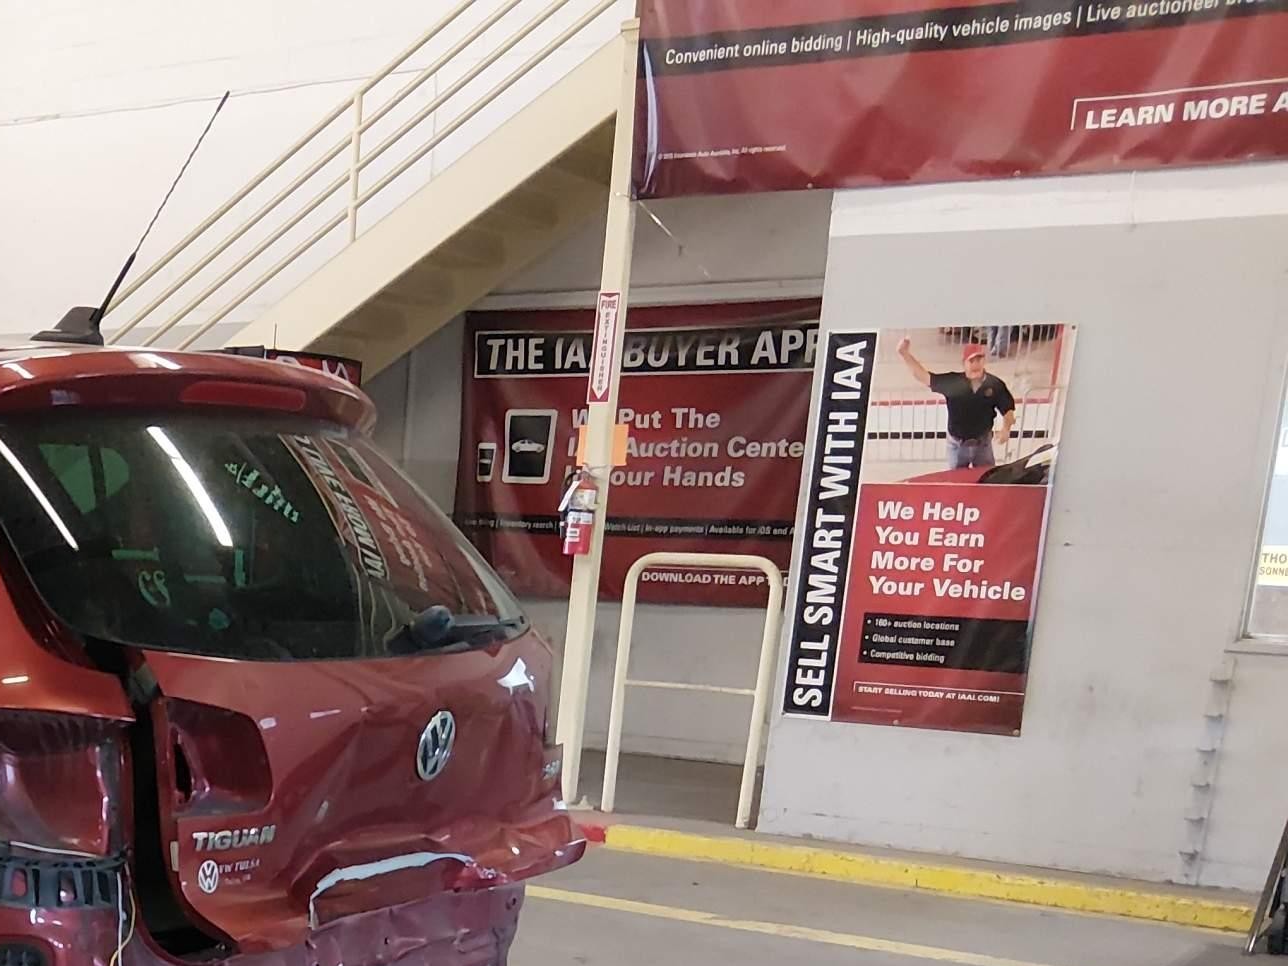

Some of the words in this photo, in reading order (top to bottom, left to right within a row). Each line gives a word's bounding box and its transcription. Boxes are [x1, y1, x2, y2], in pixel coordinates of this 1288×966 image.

[665, 43, 740, 65] Convenient
[743, 39, 787, 57] online
[791, 34, 843, 56] bidding
[856, 22, 949, 50] High-quality
[952, 16, 1010, 38] vehicle
[1014, 12, 1072, 31] images
[1086, 5, 1121, 23] Live
[1085, 103, 1174, 130] LEARN
[1182, 94, 1268, 121] MORE
[600, 300, 617, 310] FIRE
[487, 337, 545, 371] THE
[555, 337, 591, 369] IA
[623, 330, 741, 368] BUYER
[830, 339, 868, 400] IAA
[618, 408, 662, 429] Put
[671, 407, 721, 429] The
[624, 436, 724, 458] Auction
[818, 411, 859, 500] WITH
[662, 465, 745, 488] Hands
[877, 501, 915, 522] We
[922, 501, 980, 524] Help
[875, 526, 919, 546] You
[928, 527, 985, 548] Earn
[803, 507, 846, 626] SMART
[870, 550, 935, 572] More
[943, 553, 985, 574] For
[642, 571, 712, 584] DOWNLOAD
[713, 574, 736, 585] THE
[738, 575, 764, 586] APP
[868, 575, 925, 598] Your
[933, 577, 1027, 601] Vehicle
[893, 620, 922, 629] auction
[923, 620, 960, 631] locations
[872, 633, 896, 643] Global
[898, 636, 934, 645] customer
[935, 637, 955, 647] base
[870, 648, 914, 660] Competitive
[915, 652, 945, 663] bidding
[792, 635, 830, 708] SELL
[858, 686, 883, 694] START
[884, 687, 917, 697] SELLING
[918, 689, 944, 699] TODAY
[945, 692, 956, 700] AT
[192, 825, 276, 851] TIGUAN
